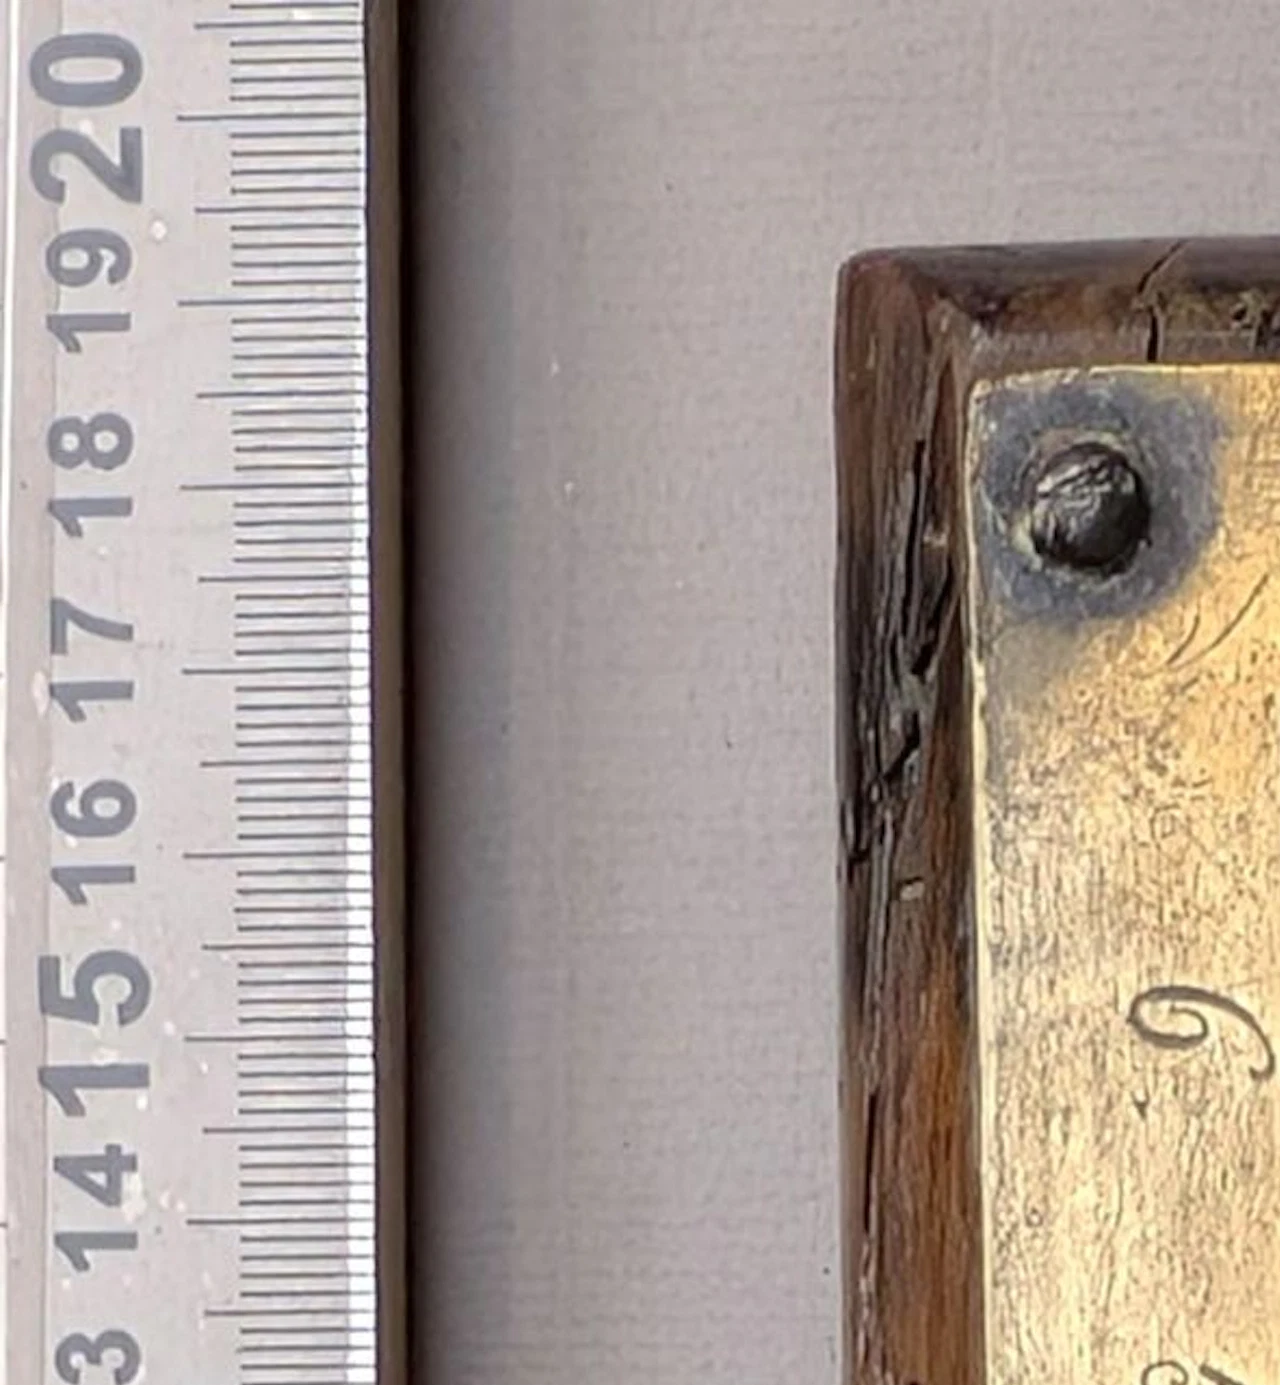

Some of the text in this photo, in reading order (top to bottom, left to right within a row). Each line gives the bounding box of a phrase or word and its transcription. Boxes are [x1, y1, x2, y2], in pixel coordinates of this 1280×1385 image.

[29, 33, 143, 205] 20
[46, 229, 132, 355] 19
[46, 412, 134, 539] 18
[48, 594, 135, 723] 17
[50, 779, 137, 906] 16
[37, 949, 152, 1117] 15
[53, 1143, 139, 1273] 14
